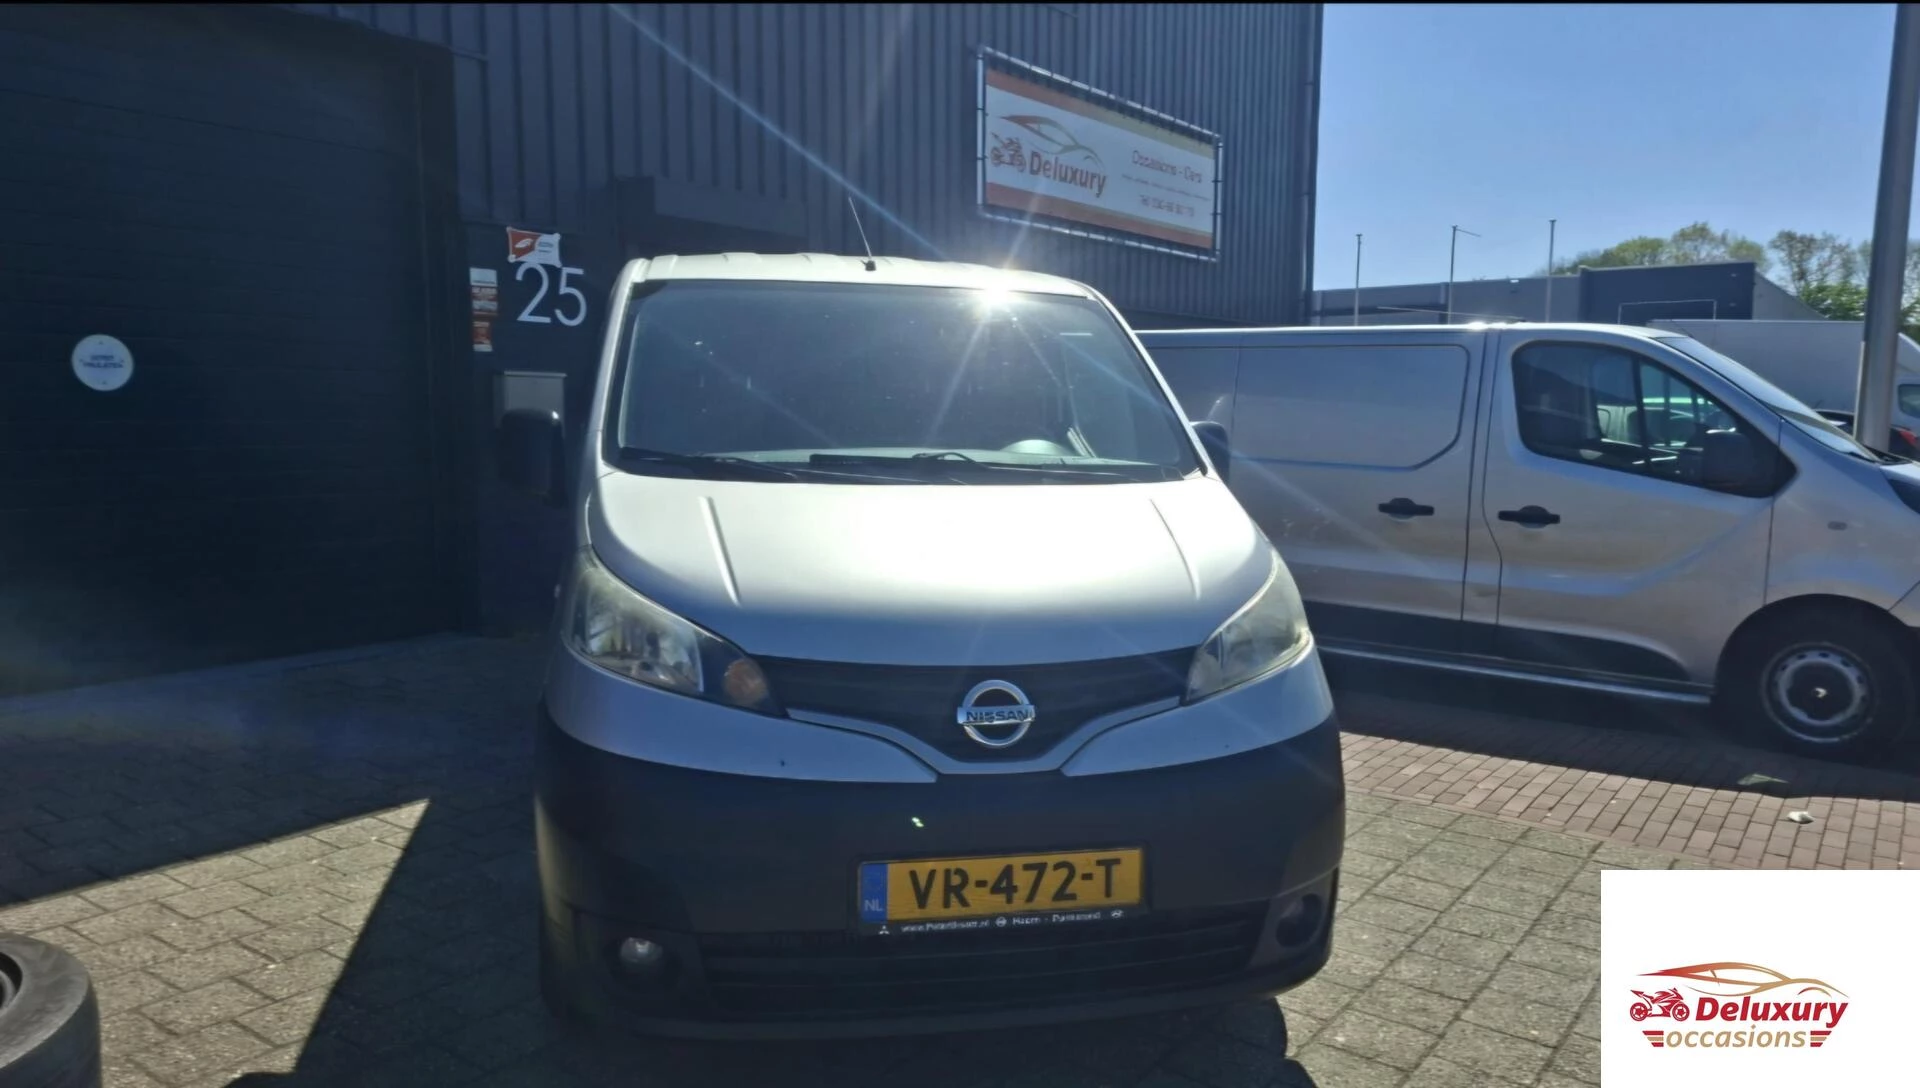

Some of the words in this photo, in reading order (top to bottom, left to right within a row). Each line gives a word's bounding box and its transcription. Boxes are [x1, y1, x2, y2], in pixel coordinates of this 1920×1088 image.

[1029, 150, 1107, 198] Deluxury
[515, 261, 587, 326] 25
[965, 710, 1029, 721] NISSAN
[864, 900, 884, 912] NL
[909, 858, 1121, 909] VR-472-T
